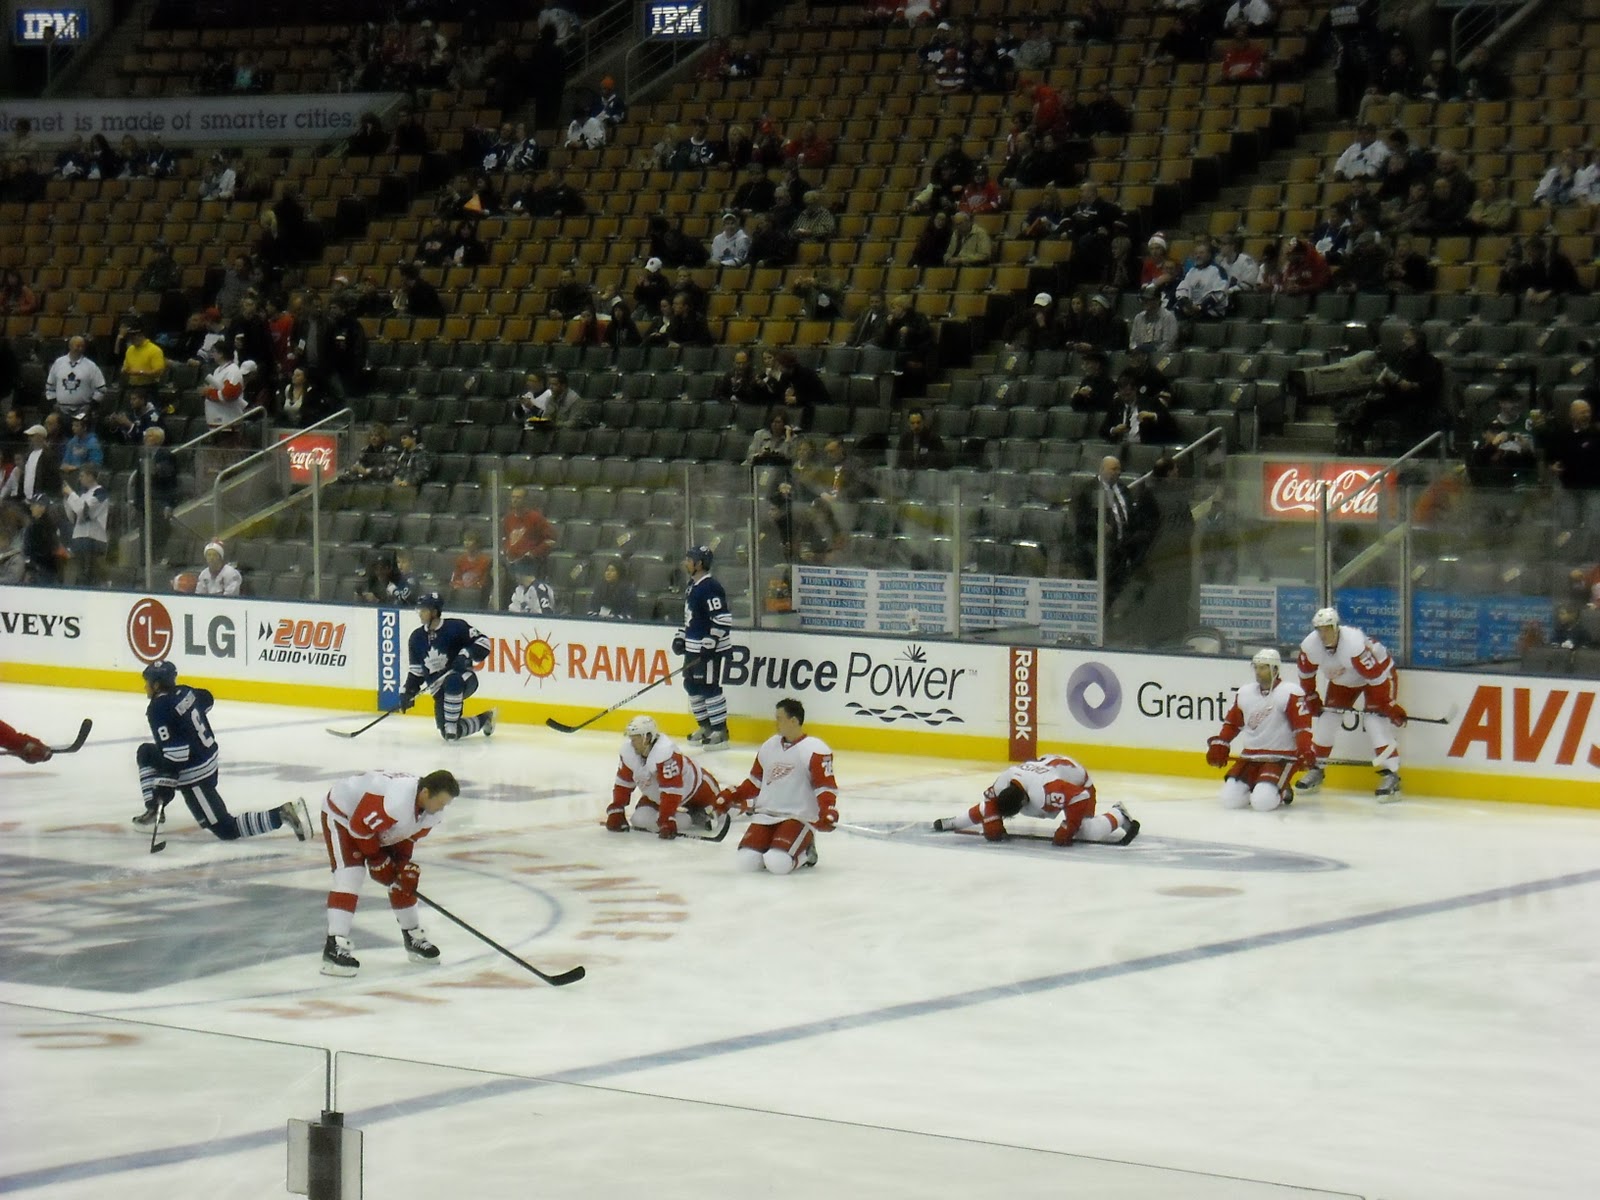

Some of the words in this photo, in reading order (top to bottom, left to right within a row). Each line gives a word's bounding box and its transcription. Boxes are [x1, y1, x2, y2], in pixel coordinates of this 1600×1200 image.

[23, 13, 79, 40] IBM
[651, 6, 704, 34] IBM
[75, 112, 92, 132] is
[101, 111, 165, 132] made
[171, 110, 192, 130] of
[200, 109, 288, 130] smarter
[706, 597, 722, 612] 18
[1366, 605, 1399, 616] randsta
[0, 611, 82, 639] VEY'S
[184, 613, 236, 659] LG
[272, 618, 347, 651] 2001
[1366, 625, 1399, 637] randsta
[381, 611, 396, 693] Reebok
[567, 643, 673, 686] RAMA
[721, 645, 838, 693] Bruce
[844, 651, 966, 700] Power
[1014, 650, 1032, 740] Reebok
[157, 725, 170, 741] 8
[1447, 685, 1600, 769] AVI
[662, 760, 681, 779] 55
